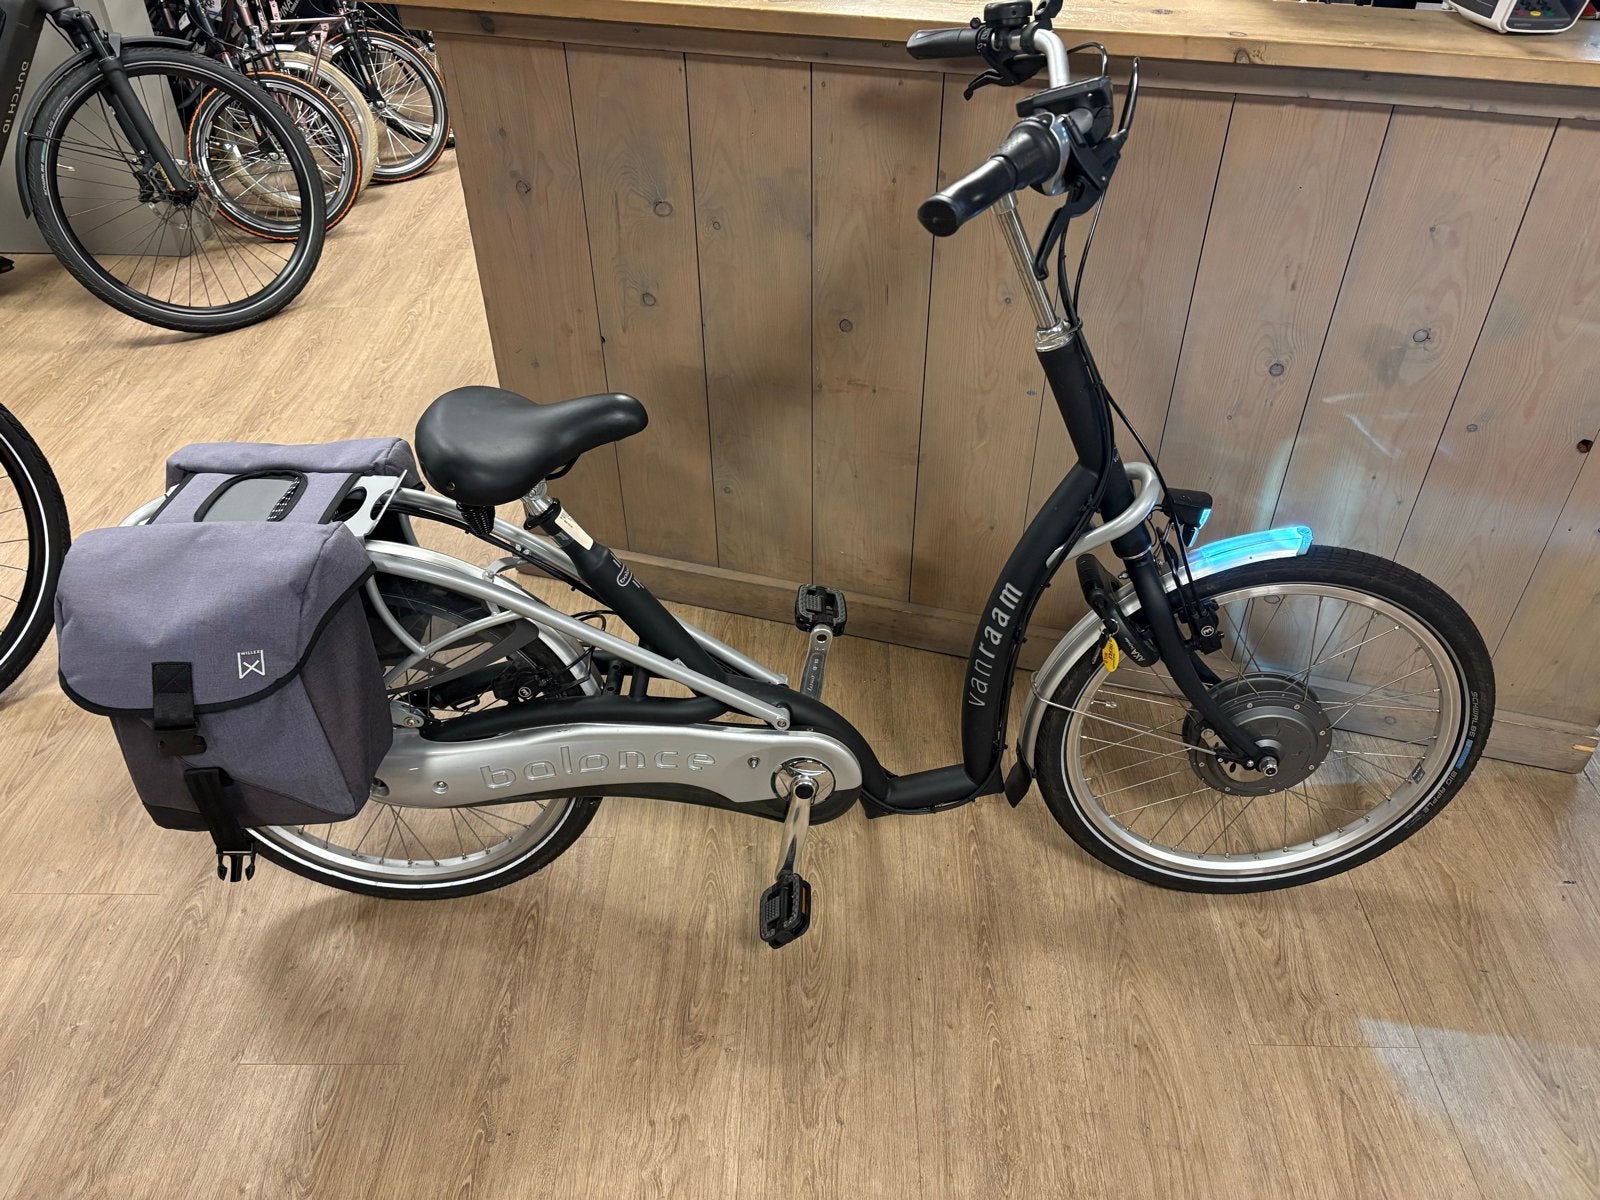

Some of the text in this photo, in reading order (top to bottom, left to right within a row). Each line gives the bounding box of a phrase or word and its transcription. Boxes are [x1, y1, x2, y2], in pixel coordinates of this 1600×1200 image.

[2, 61, 29, 133] DUTCH ID
[1468, 691, 1479, 738] SCHWALBE
[1423, 788, 1446, 814] APPLE
